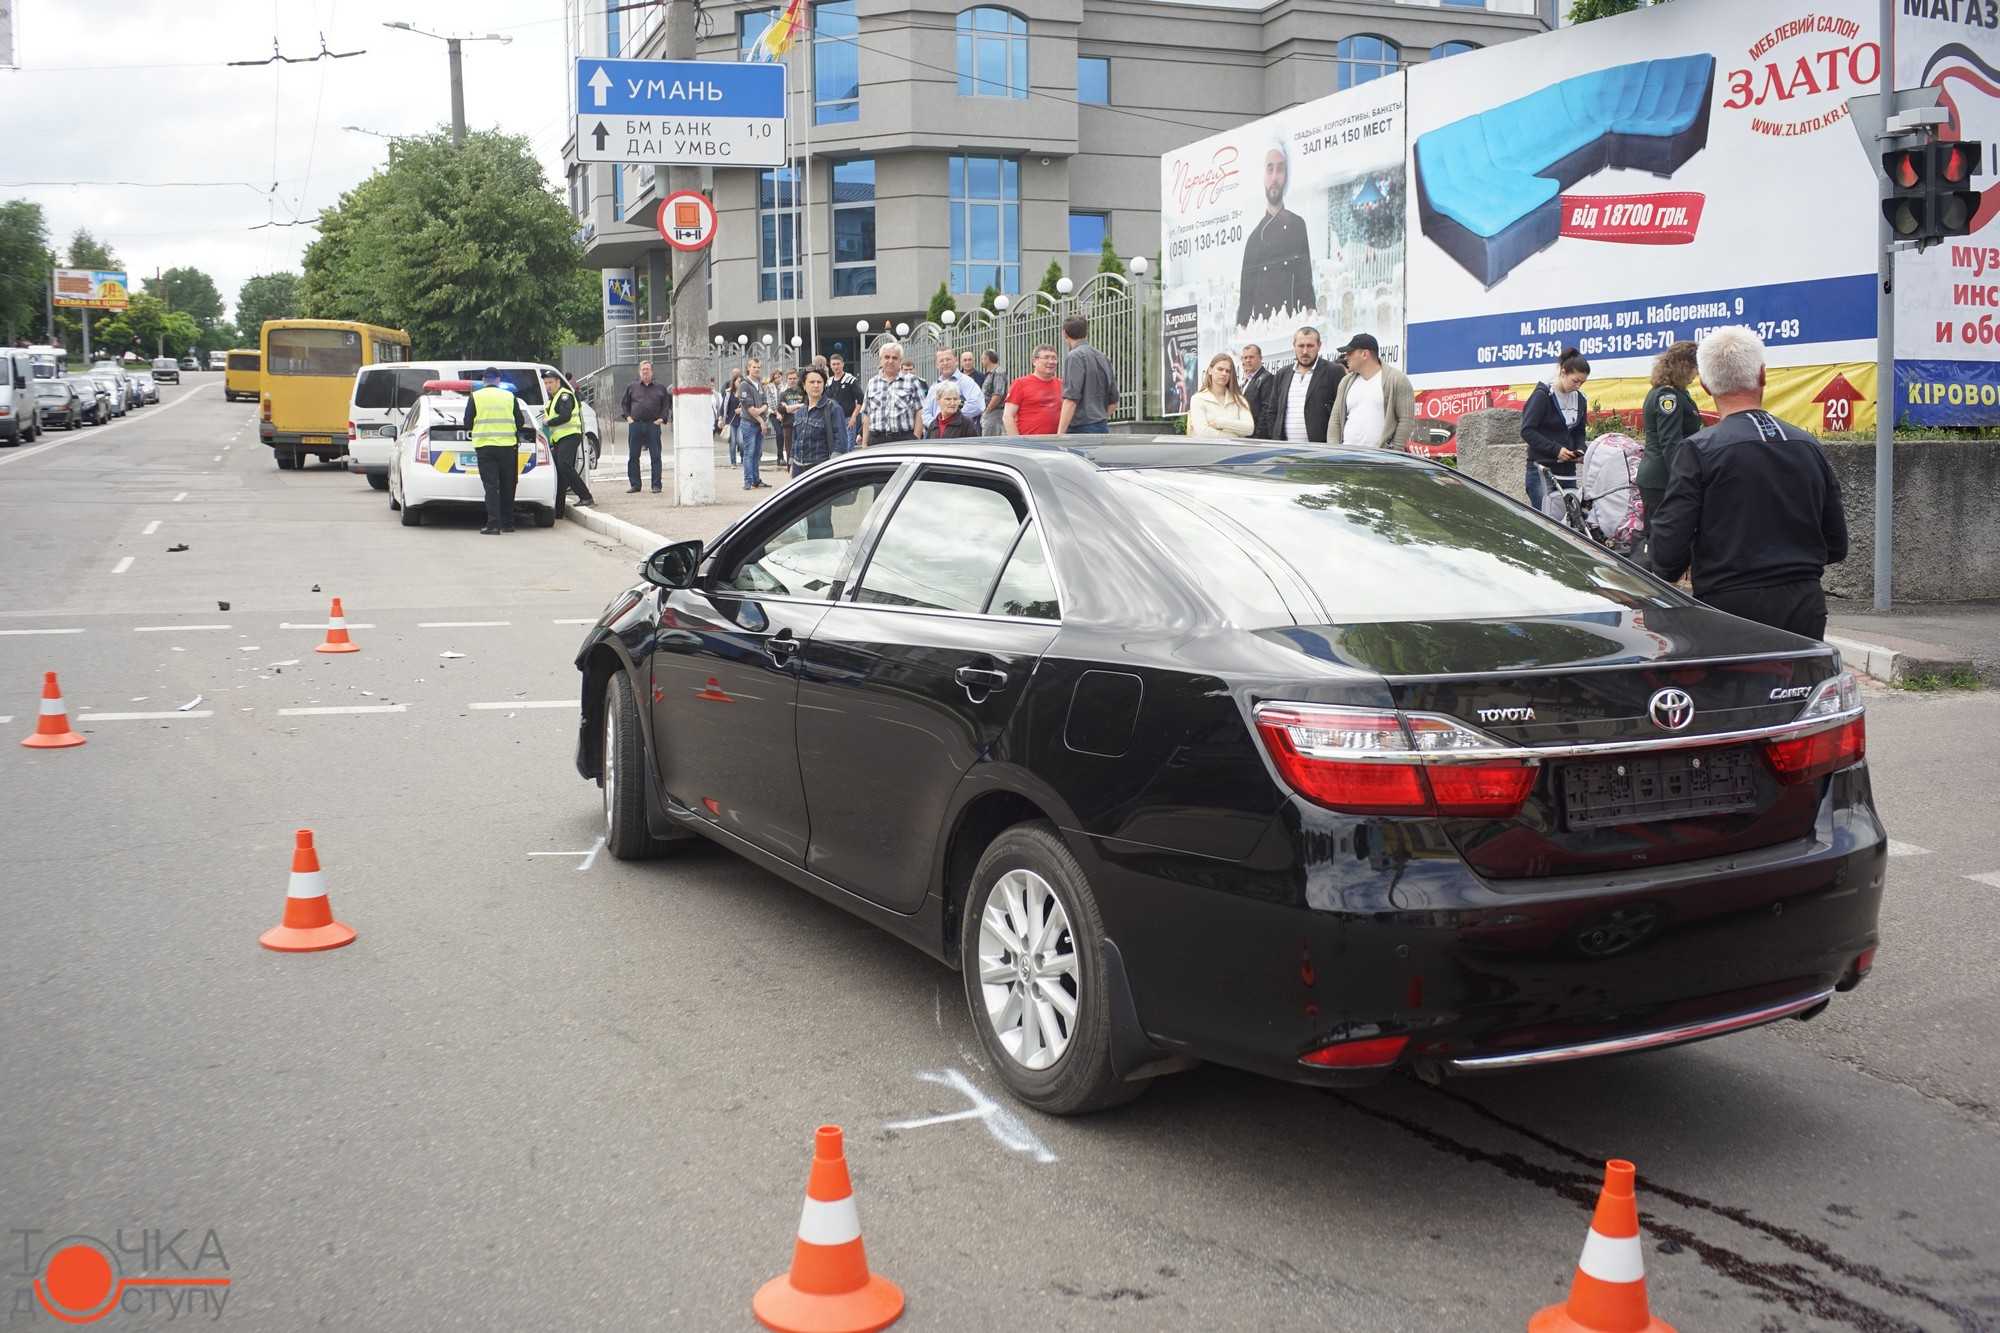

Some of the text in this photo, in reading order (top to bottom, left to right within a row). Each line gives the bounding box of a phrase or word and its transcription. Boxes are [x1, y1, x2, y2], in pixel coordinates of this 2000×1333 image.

[1903, 0, 1998, 29] МАГАЗ
[1748, 13, 1860, 61] МЕБЛЕВИЙ САЛОН
[627, 79, 724, 101] УМАНЬ
[1723, 42, 1881, 110] ЗЛАТО
[626, 121, 772, 140] БМ БАНК 1,0
[1751, 101, 1850, 137] WWW.ZLATO.KR.U
[626, 139, 732, 156] ДАІ УМВС
[1302, 118, 1393, 156] ЗАЛ НА 150 МЕСТ
[1570, 203, 1689, 229] від 18700 грн.
[1169, 224, 1242, 262] (050) 130-12-00
[1520, 297, 1744, 336] м. Кіровоград, вул. Набережна, 9
[1477, 340, 1562, 364] 067-560-75-43
[1579, 331, 1675, 355] 095-318-56-70
[1826, 398, 1849, 418] 20
[1477, 707, 1537, 722] TOYOTA
